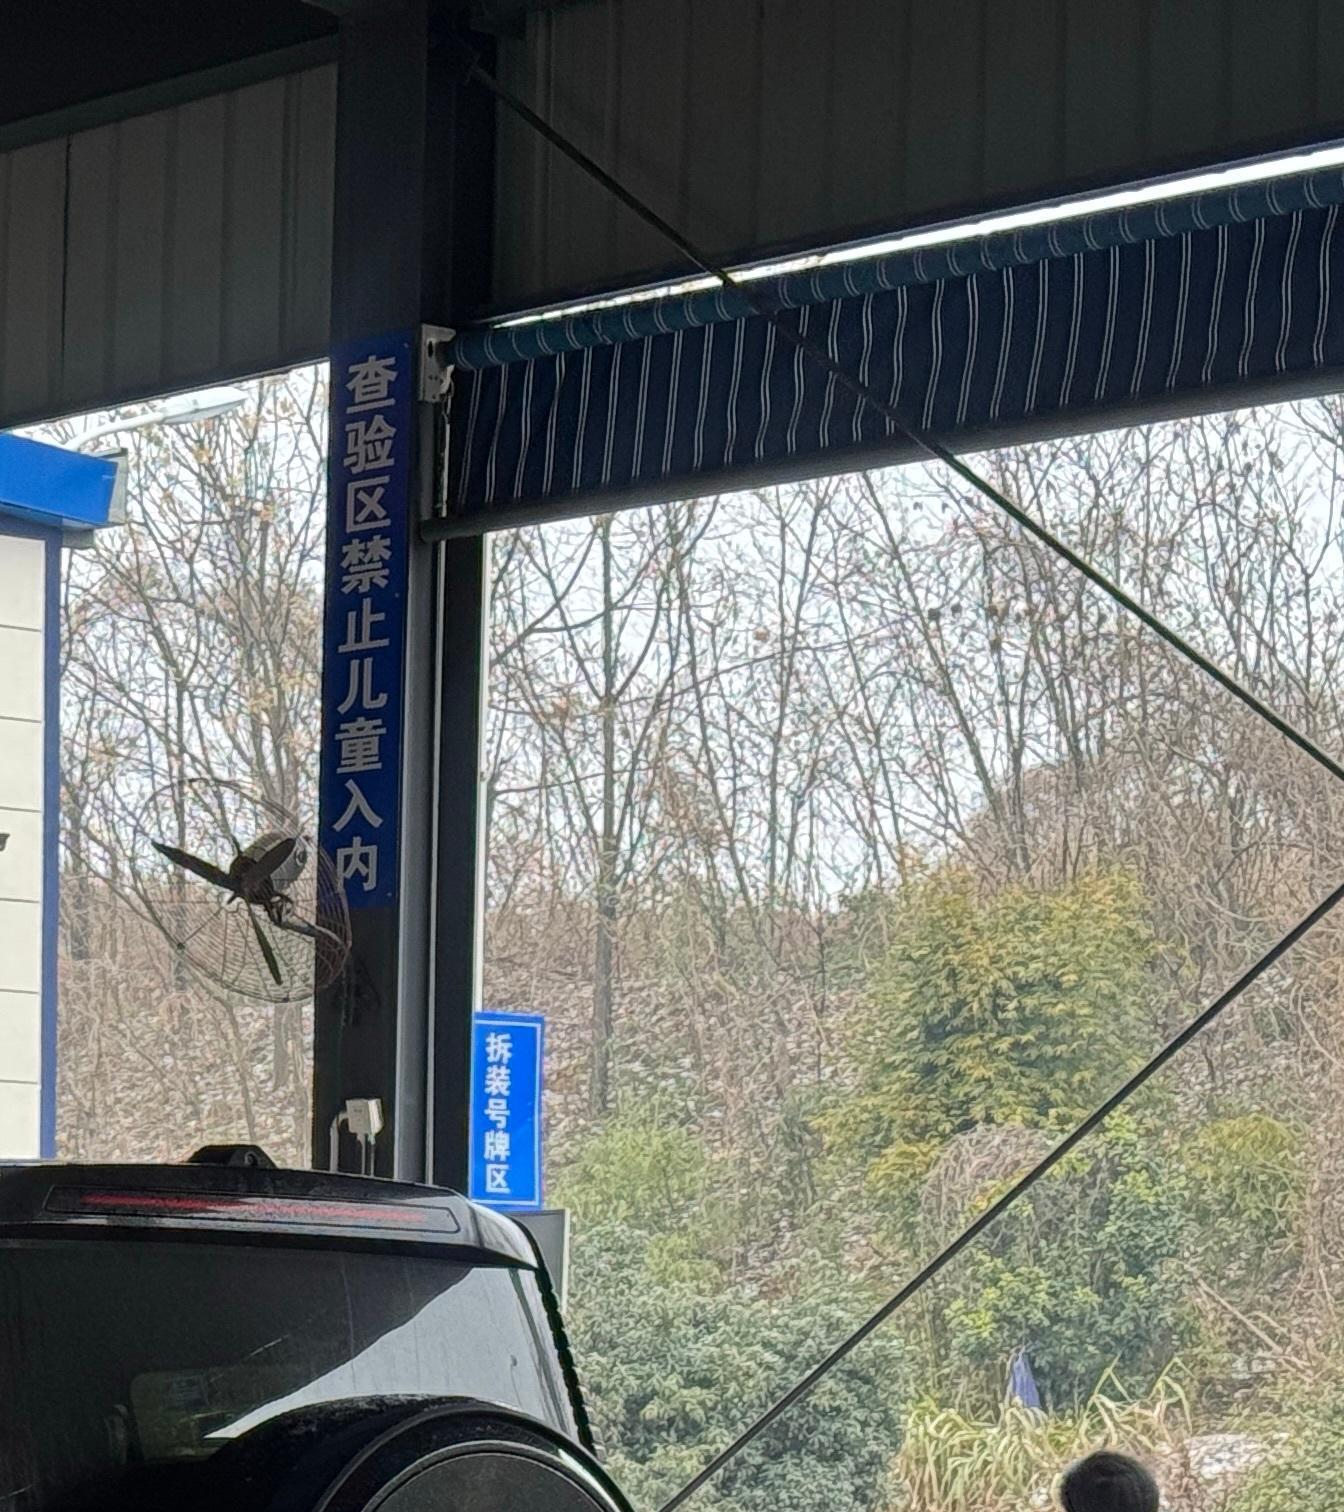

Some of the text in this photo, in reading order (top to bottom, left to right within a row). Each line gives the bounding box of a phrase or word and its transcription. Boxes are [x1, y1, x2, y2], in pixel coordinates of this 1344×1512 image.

[333, 356, 398, 893] 查验区禁止儿童入内
[483, 1032, 514, 1194] 拆装号牌区
